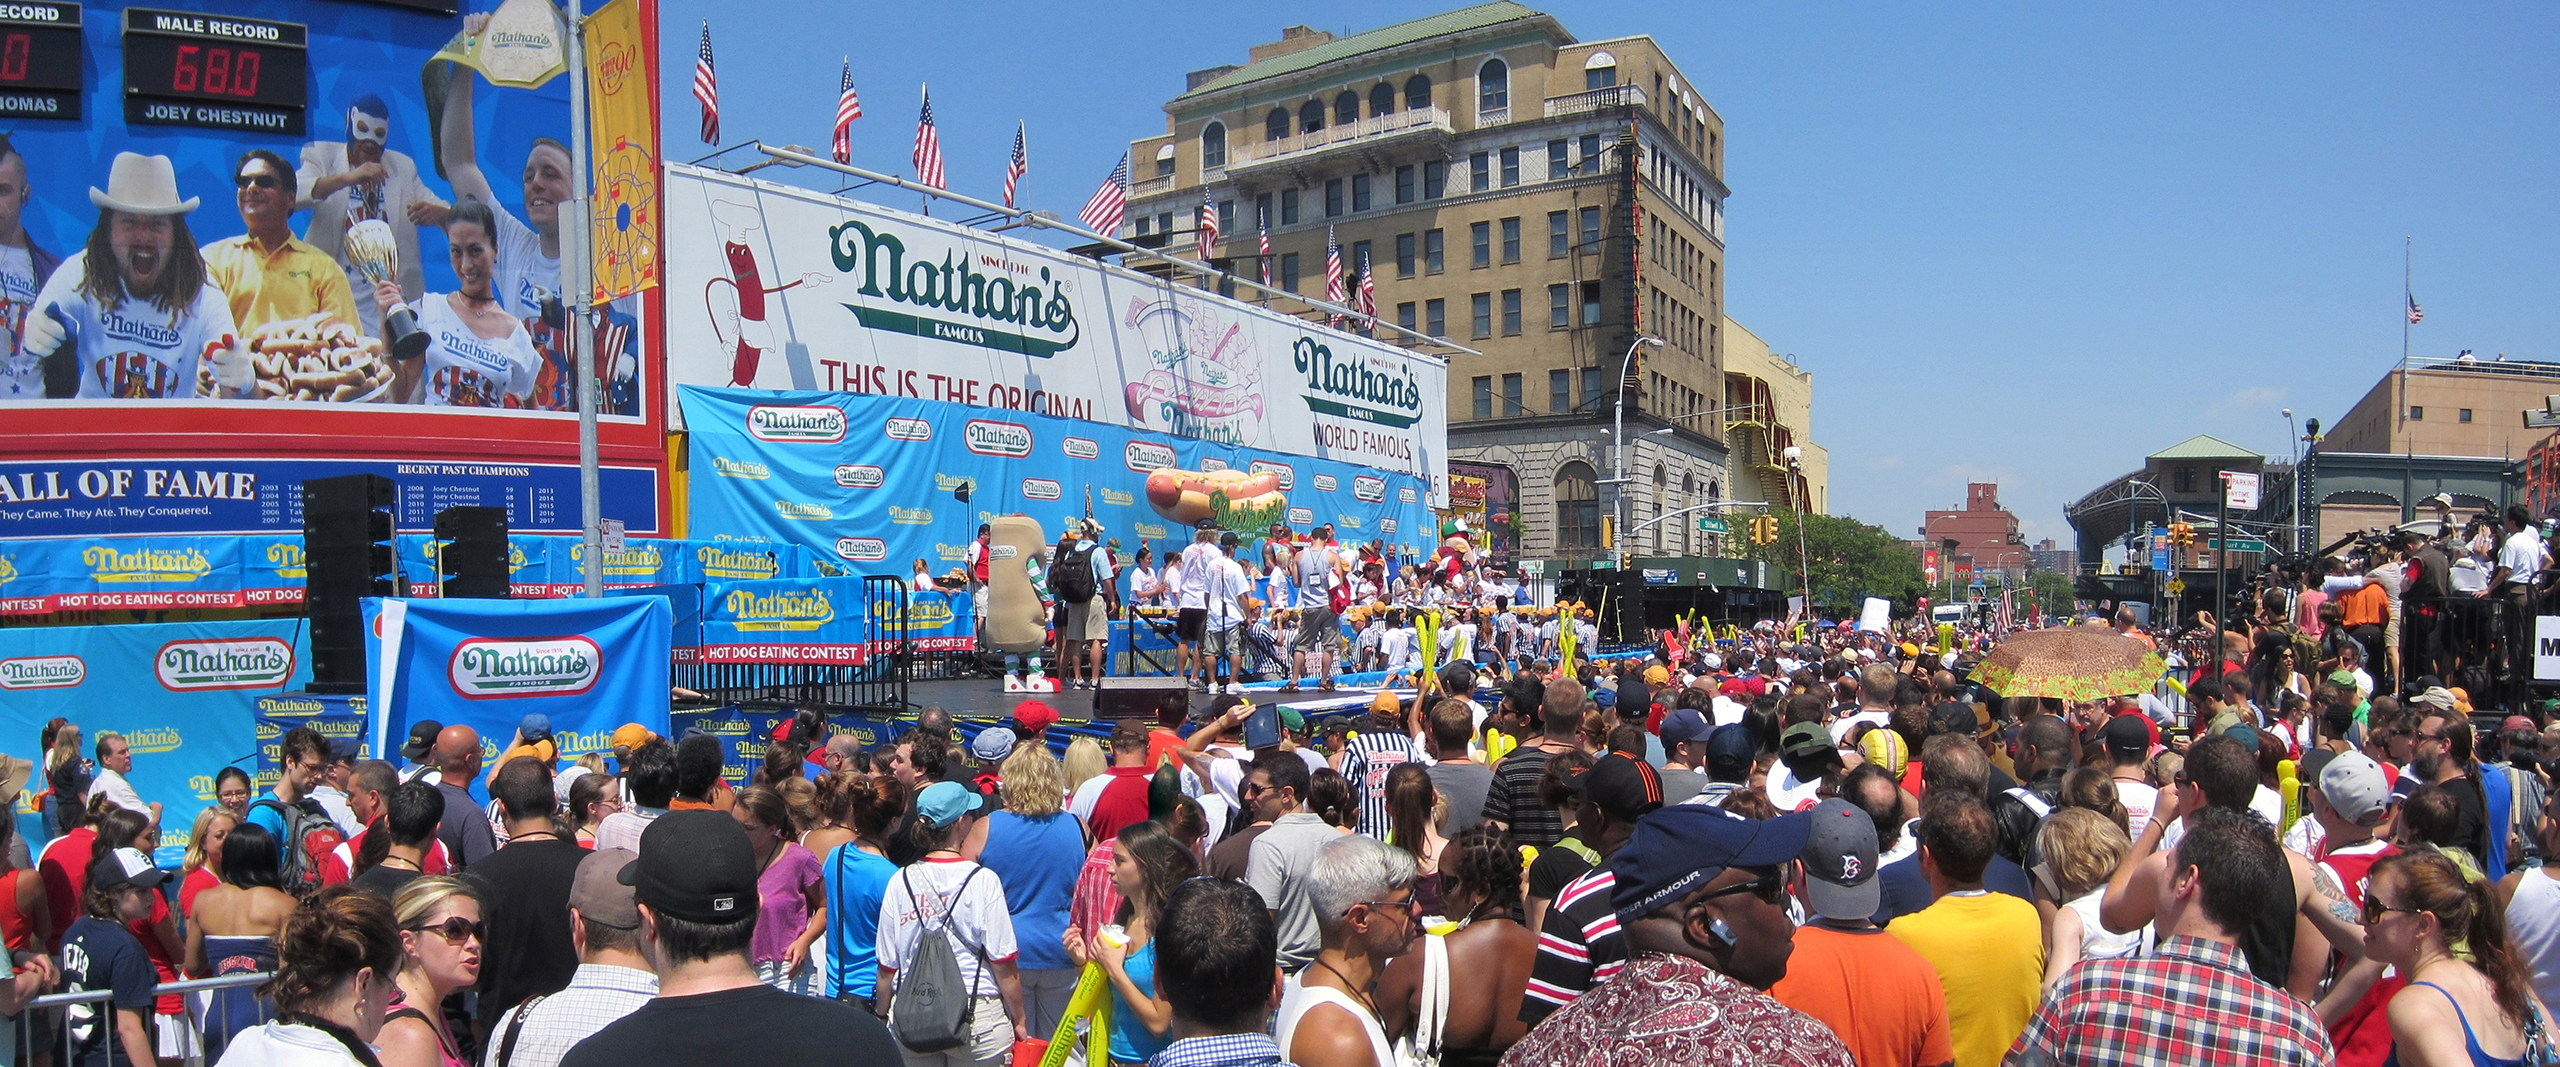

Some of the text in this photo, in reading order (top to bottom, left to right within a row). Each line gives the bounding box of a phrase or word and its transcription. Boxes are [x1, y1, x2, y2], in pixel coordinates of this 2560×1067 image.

[156, 16, 279, 40] MALE RECORD
[492, 31, 551, 45] Nathan's
[173, 45, 260, 96] 68.0
[0, 97, 58, 112] OMAS
[146, 105, 287, 128] JOEY CHESTNUT
[829, 220, 1075, 334] Nathan's
[935, 322, 985, 344] FAMOUS
[820, 359, 887, 397] THIS
[897, 369, 919, 399] IS
[927, 373, 979, 406] THE
[1293, 337, 1420, 411] Nathan's
[754, 409, 842, 430] Nathan's
[969, 424, 1028, 447] Nathan's
[1313, 422, 1411, 460] WORLD FAMOUS
[397, 464, 530, 477] RECENT PAST CHAMPIONS
[713, 457, 769, 476] Nathan's
[78, 469, 133, 499] OF
[144, 470, 257, 500] FAME
[433, 485, 448, 493] Joey
[2233, 478, 2257, 487] PARKING
[2227, 490, 2250, 498] ANYTIME
[27, 510, 62, 518] Came.
[64, 508, 92, 519] They
[95, 508, 116, 517] Ate.
[118, 506, 146, 518] They
[148, 505, 211, 517] Conquered.
[83, 547, 209, 573] Nathan's
[60, 593, 236, 607] HOT DOG EATING CONTEST
[246, 589, 303, 602] HOT DOG
[553, 586, 575, 595] HOT
[727, 587, 833, 620] Nathan's
[672, 649, 695, 660] TEST
[709, 645, 858, 661] HOT DOG EATING CONTEST
[931, 638, 967, 650] CONTEST
[2, 660, 80, 679] Nathan's
[165, 646, 286, 673] Nathan's
[463, 647, 588, 679] Nathan's
[259, 699, 322, 712] Nathan's
[306, 720, 361, 732] Nathan'
[554, 730, 614, 752] Nath
[1644, 870, 1701, 905] ARMOUR
[517, 996, 546, 1024] Canon
